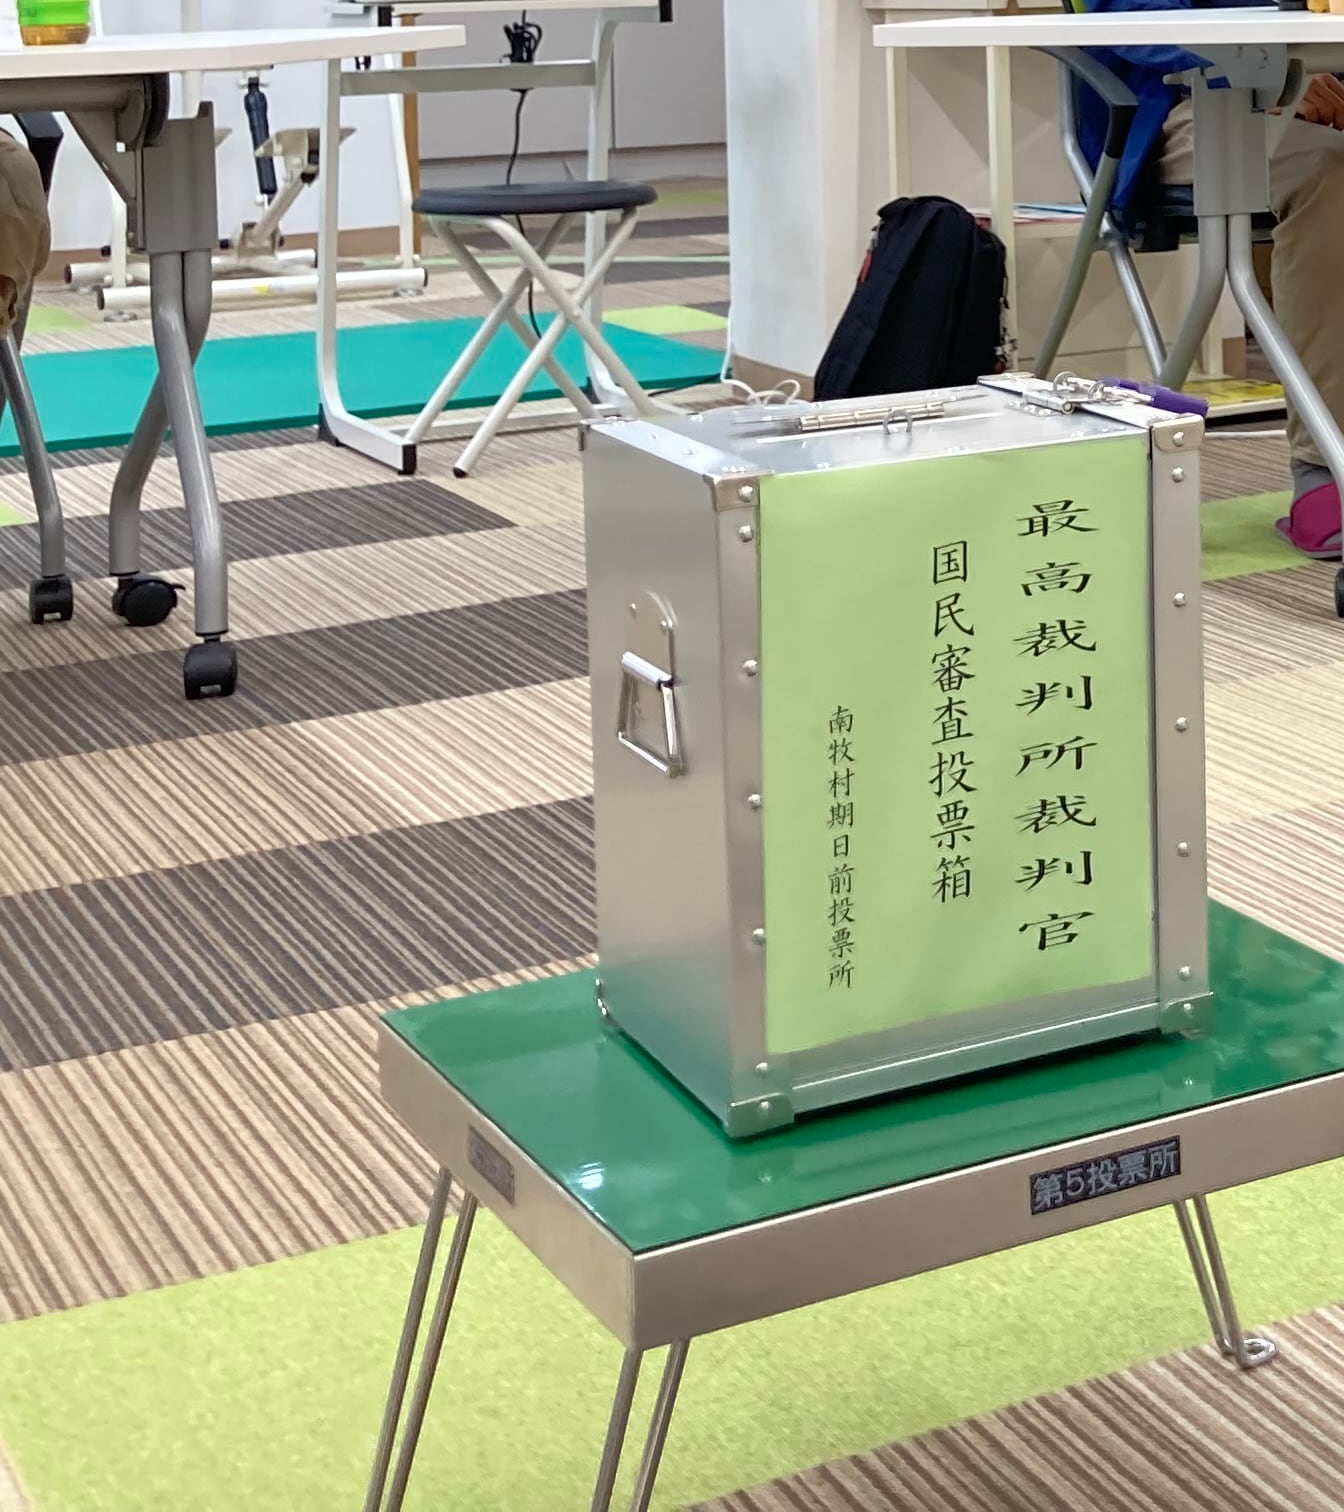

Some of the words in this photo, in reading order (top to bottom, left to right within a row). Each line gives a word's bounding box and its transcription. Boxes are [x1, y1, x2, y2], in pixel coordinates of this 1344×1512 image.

[825, 703, 857, 990] 南牧村期日前投票所
[926, 538, 977, 904] 国民審査投票箱
[1015, 497, 1101, 953] 最高裁判所裁判官
[1033, 1141, 1178, 1211] 第5投票所
